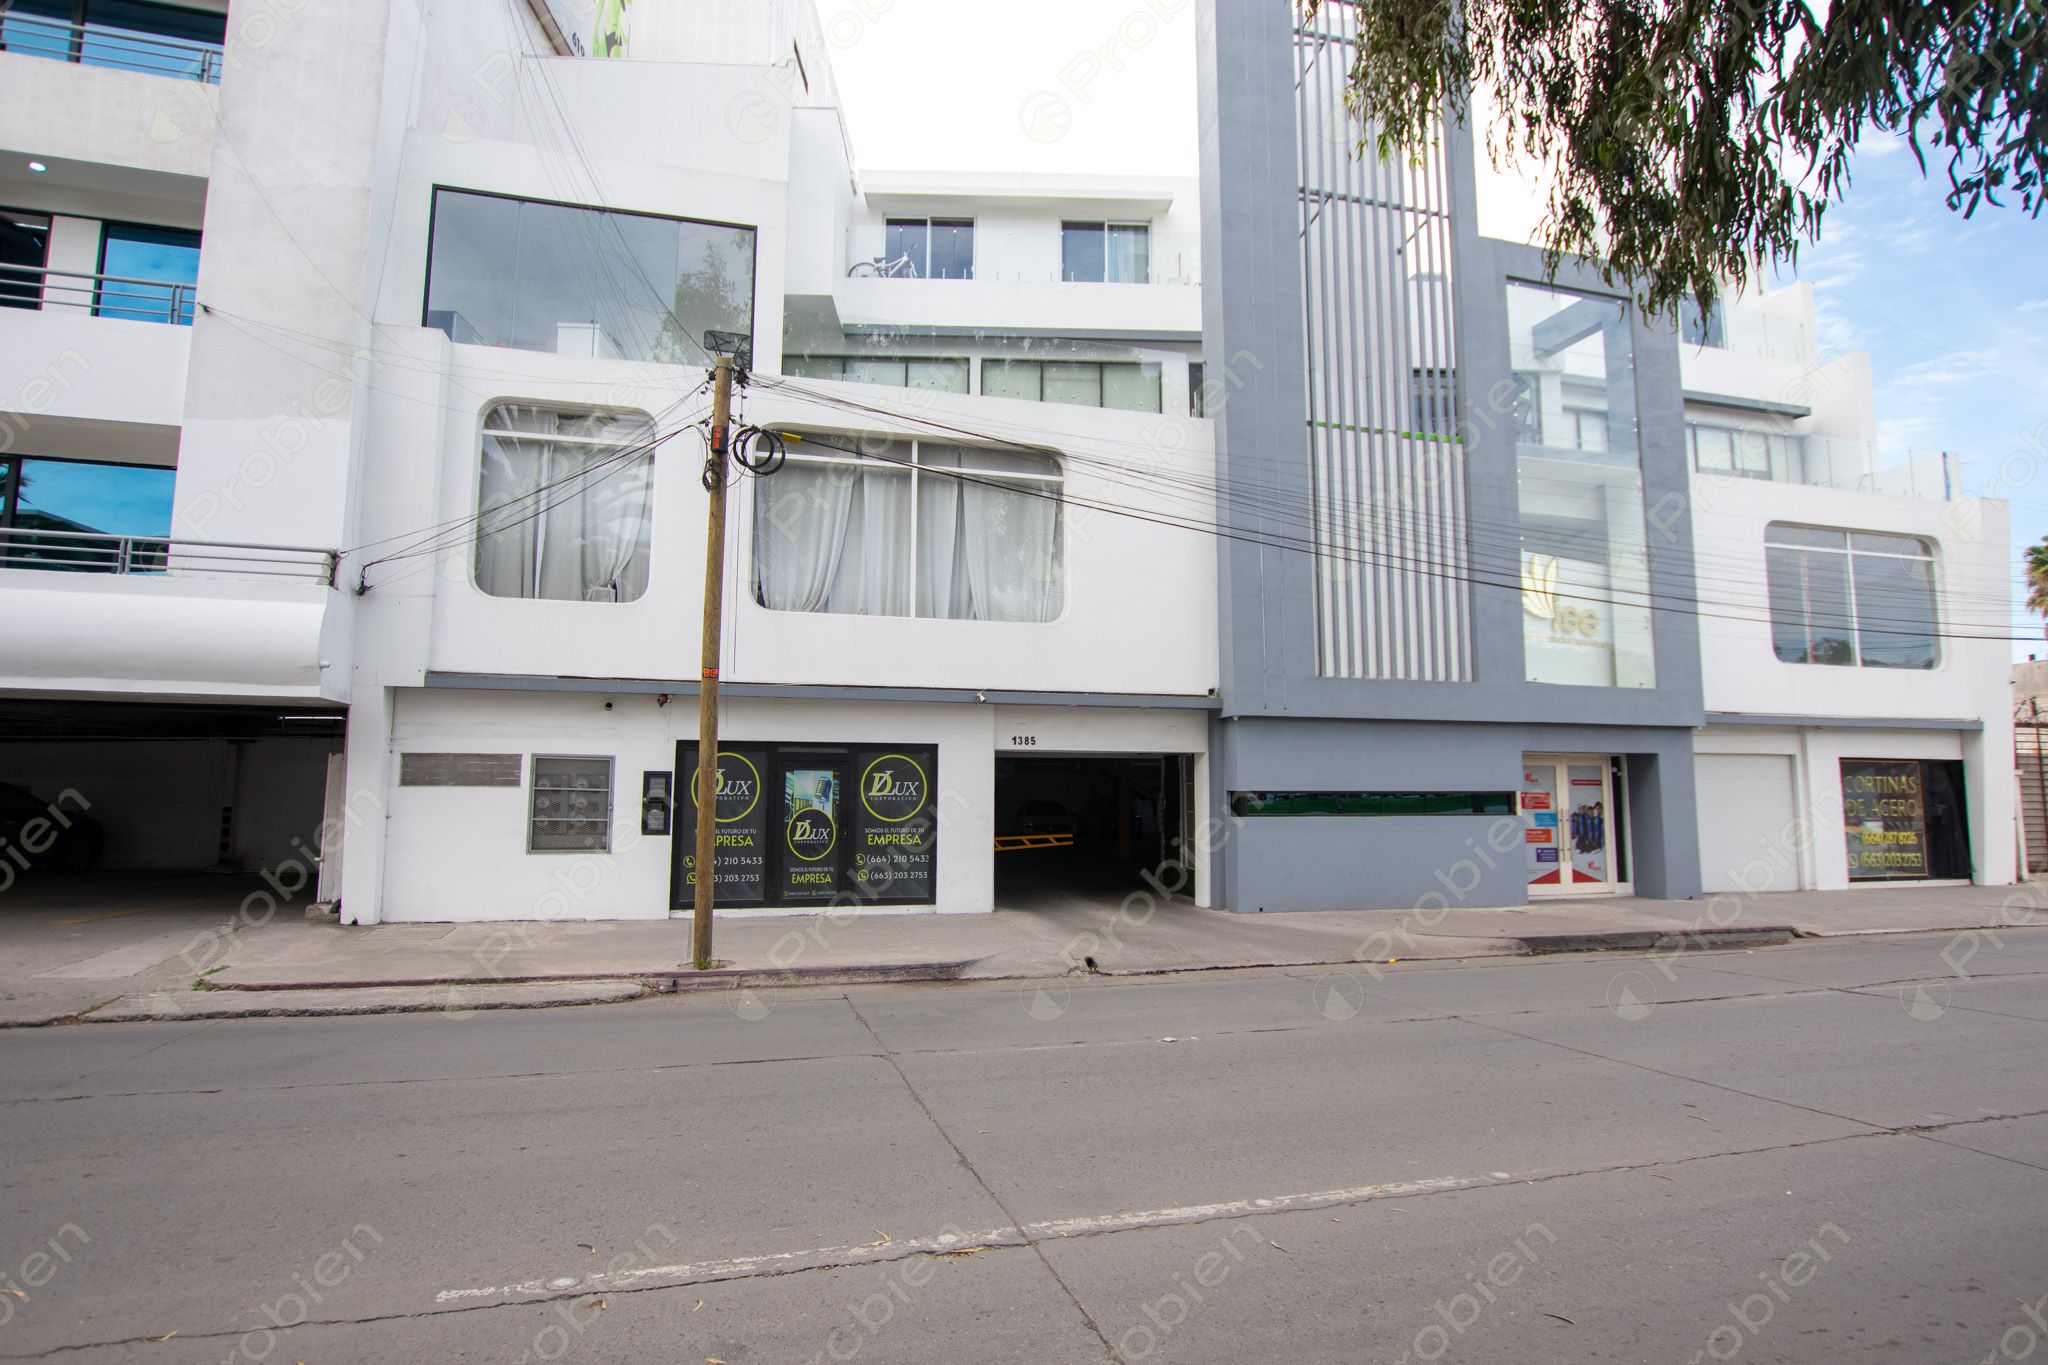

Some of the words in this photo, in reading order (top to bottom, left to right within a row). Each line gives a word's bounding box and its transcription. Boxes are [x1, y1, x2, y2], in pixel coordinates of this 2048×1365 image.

[1011, 735, 1036, 746] 1385
[1843, 774, 1918, 793] CORTINAS
[1845, 798, 1866, 817] DE
[1870, 798, 1917, 817] ACERO
[715, 835, 754, 847] PRESA
[867, 834, 922, 846] EMPRESA
[724, 857, 739, 865] 210
[741, 857, 763, 865] 5433
[866, 854, 891, 864] (664)
[893, 855, 908, 863] 210
[791, 873, 832, 884] EMPRESA
[870, 871, 892, 880] (663)
